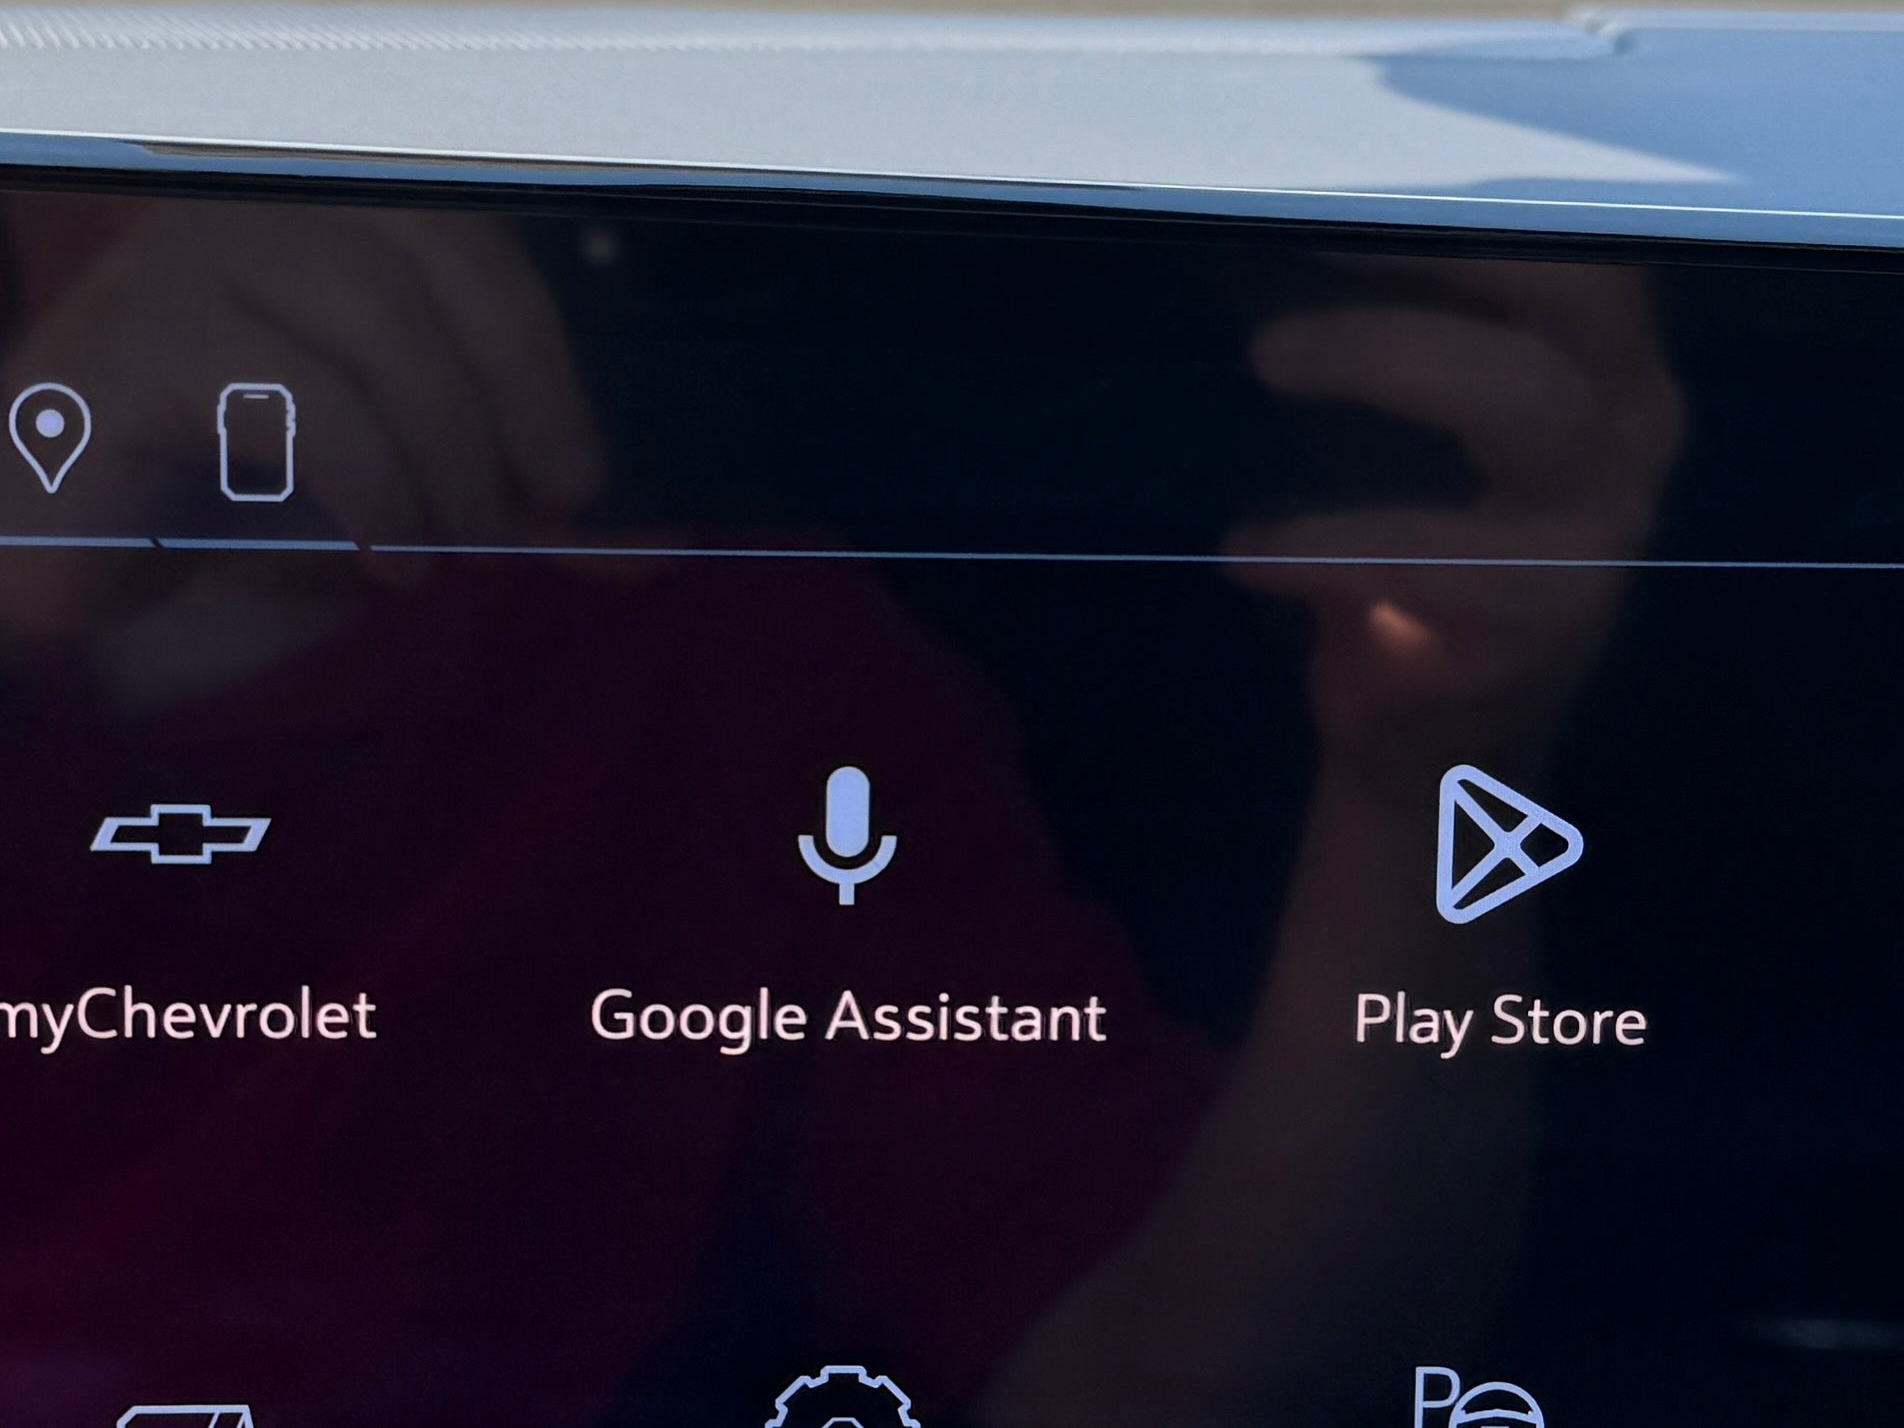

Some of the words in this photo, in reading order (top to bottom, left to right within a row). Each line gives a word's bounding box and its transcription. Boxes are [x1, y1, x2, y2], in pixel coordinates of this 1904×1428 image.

[591, 986, 807, 1056] Google
[824, 989, 1107, 1042] Assistant
[1356, 990, 1474, 1060] Play
[1491, 994, 1647, 1046] Store
